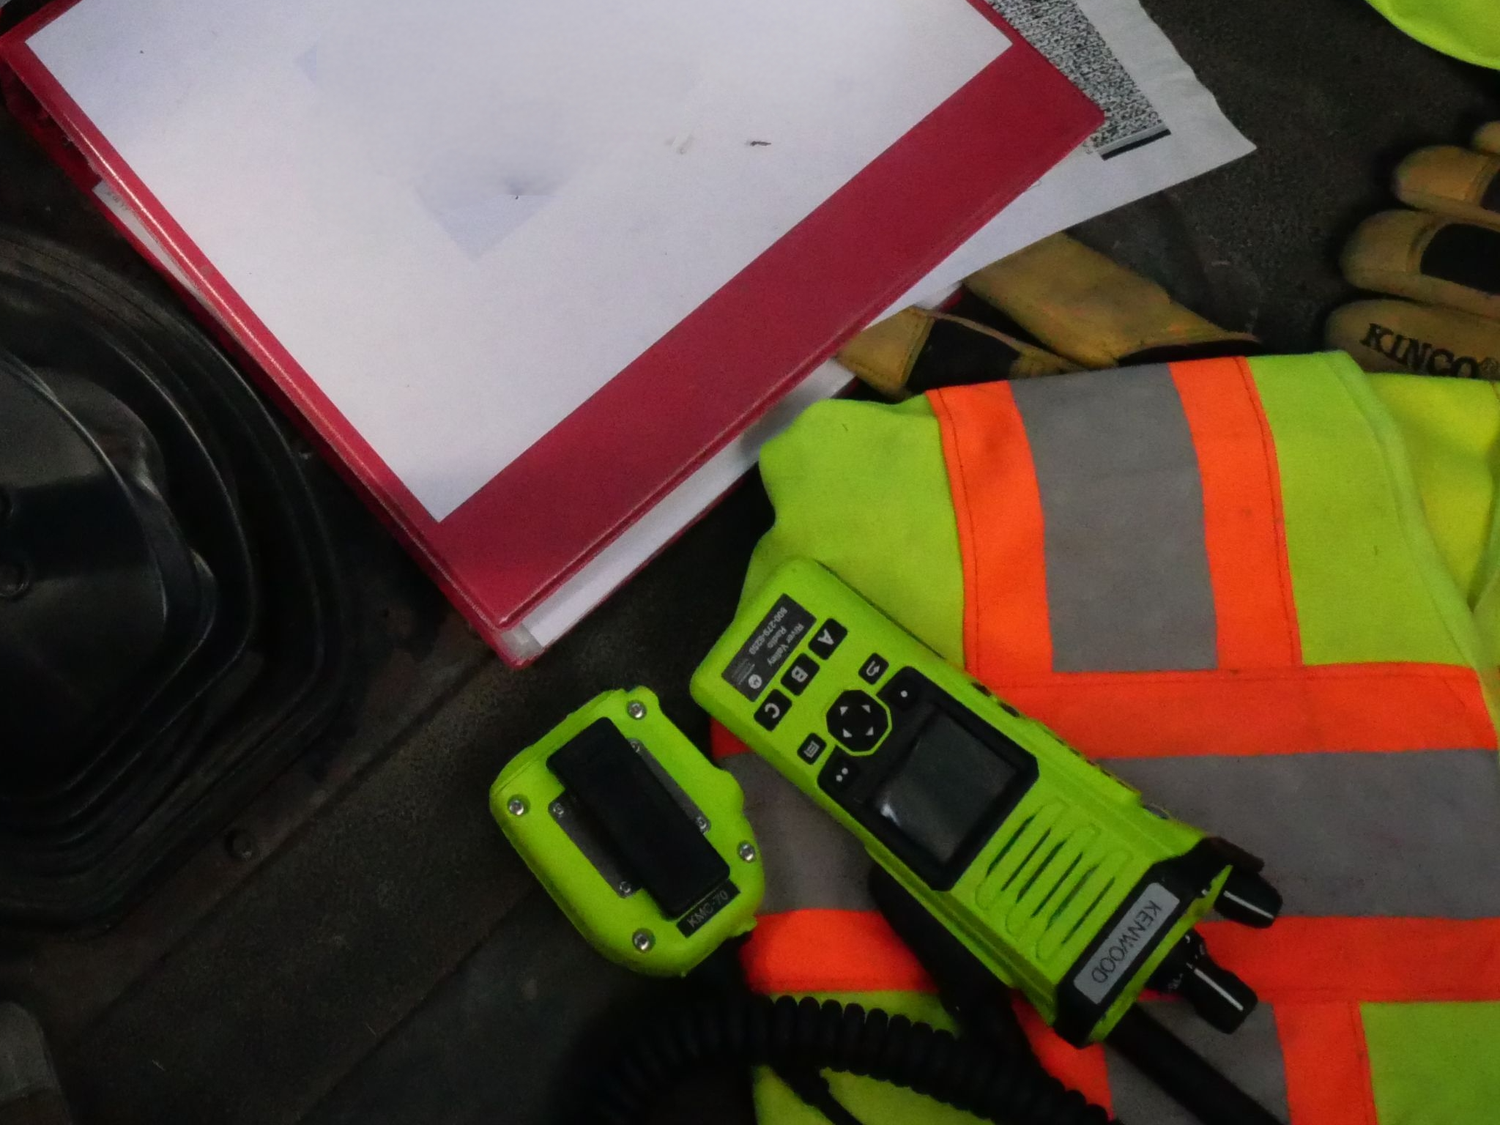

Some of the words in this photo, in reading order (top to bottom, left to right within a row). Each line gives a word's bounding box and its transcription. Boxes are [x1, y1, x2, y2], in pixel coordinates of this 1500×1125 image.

[1360, 323, 1480, 378] KINCO
[817, 628, 834, 645] A
[791, 665, 808, 683] B
[764, 702, 780, 719] C
[687, 890, 728, 928] KMC-70
[1091, 900, 1162, 984] KENWOOD
